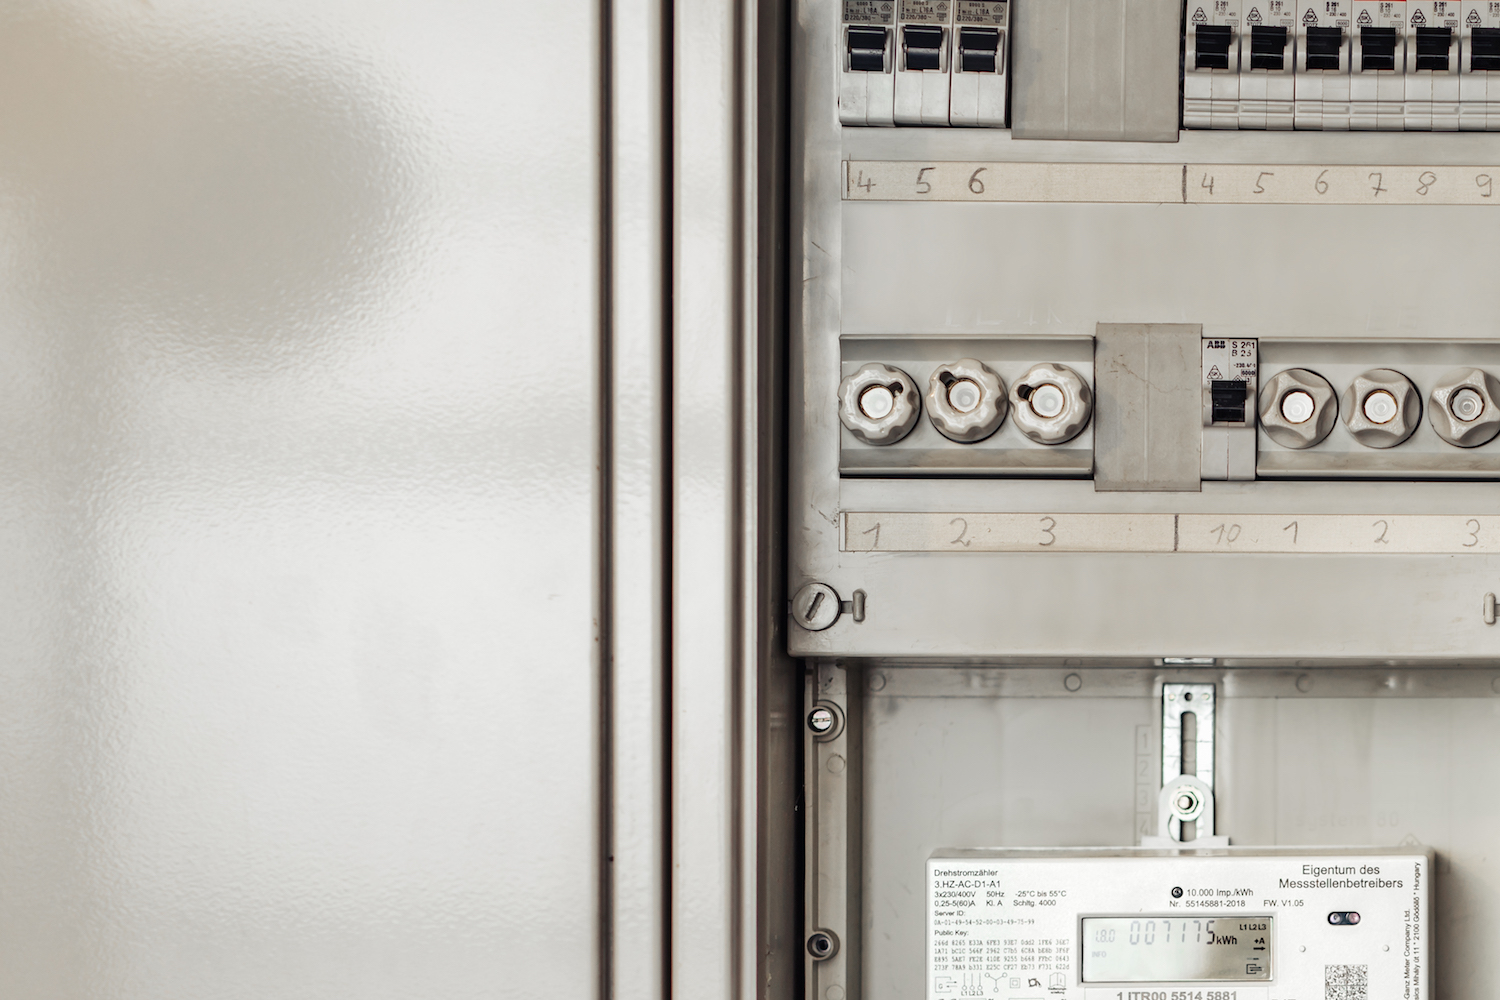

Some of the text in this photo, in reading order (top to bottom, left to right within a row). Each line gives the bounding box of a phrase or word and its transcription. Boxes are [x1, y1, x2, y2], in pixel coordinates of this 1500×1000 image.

[857, 167, 987, 194] 4 5 6
[1201, 170, 1492, 197] 4 5 6 7 8 9
[1207, 341, 1226, 349] ABB
[1232, 341, 1238, 349] S
[859, 516, 1057, 552] 1 2 3
[1210, 519, 1483, 547] 10 1 2 3
[934, 869, 999, 877] Drehstromzähler
[1302, 864, 1380, 877] Eigentum des
[1412, 862, 1421, 891] Hungary
[934, 880, 1001, 888] 3.HZ-AC-D1-A1
[1278, 878, 1404, 889] Messstellenbetreibers
[934, 890, 976, 898] 3x230/400V
[986, 890, 1005, 898] 50Hz
[1015, 890, 1035, 898] -25°C
[1187, 888, 1254, 898] 10.000 Imp./kWh
[1263, 899, 1305, 907] FW. V1.05
[1403, 908, 1411, 922] Ltd.
[1129, 920, 1238, 945] 007175 kWh
[1239, 923, 1267, 931] L1 L2 L3
[1254, 937, 1265, 945] +A
[1403, 923, 1412, 957] Company
[1413, 947, 1420, 955] 11
[1403, 958, 1411, 979] Meter
